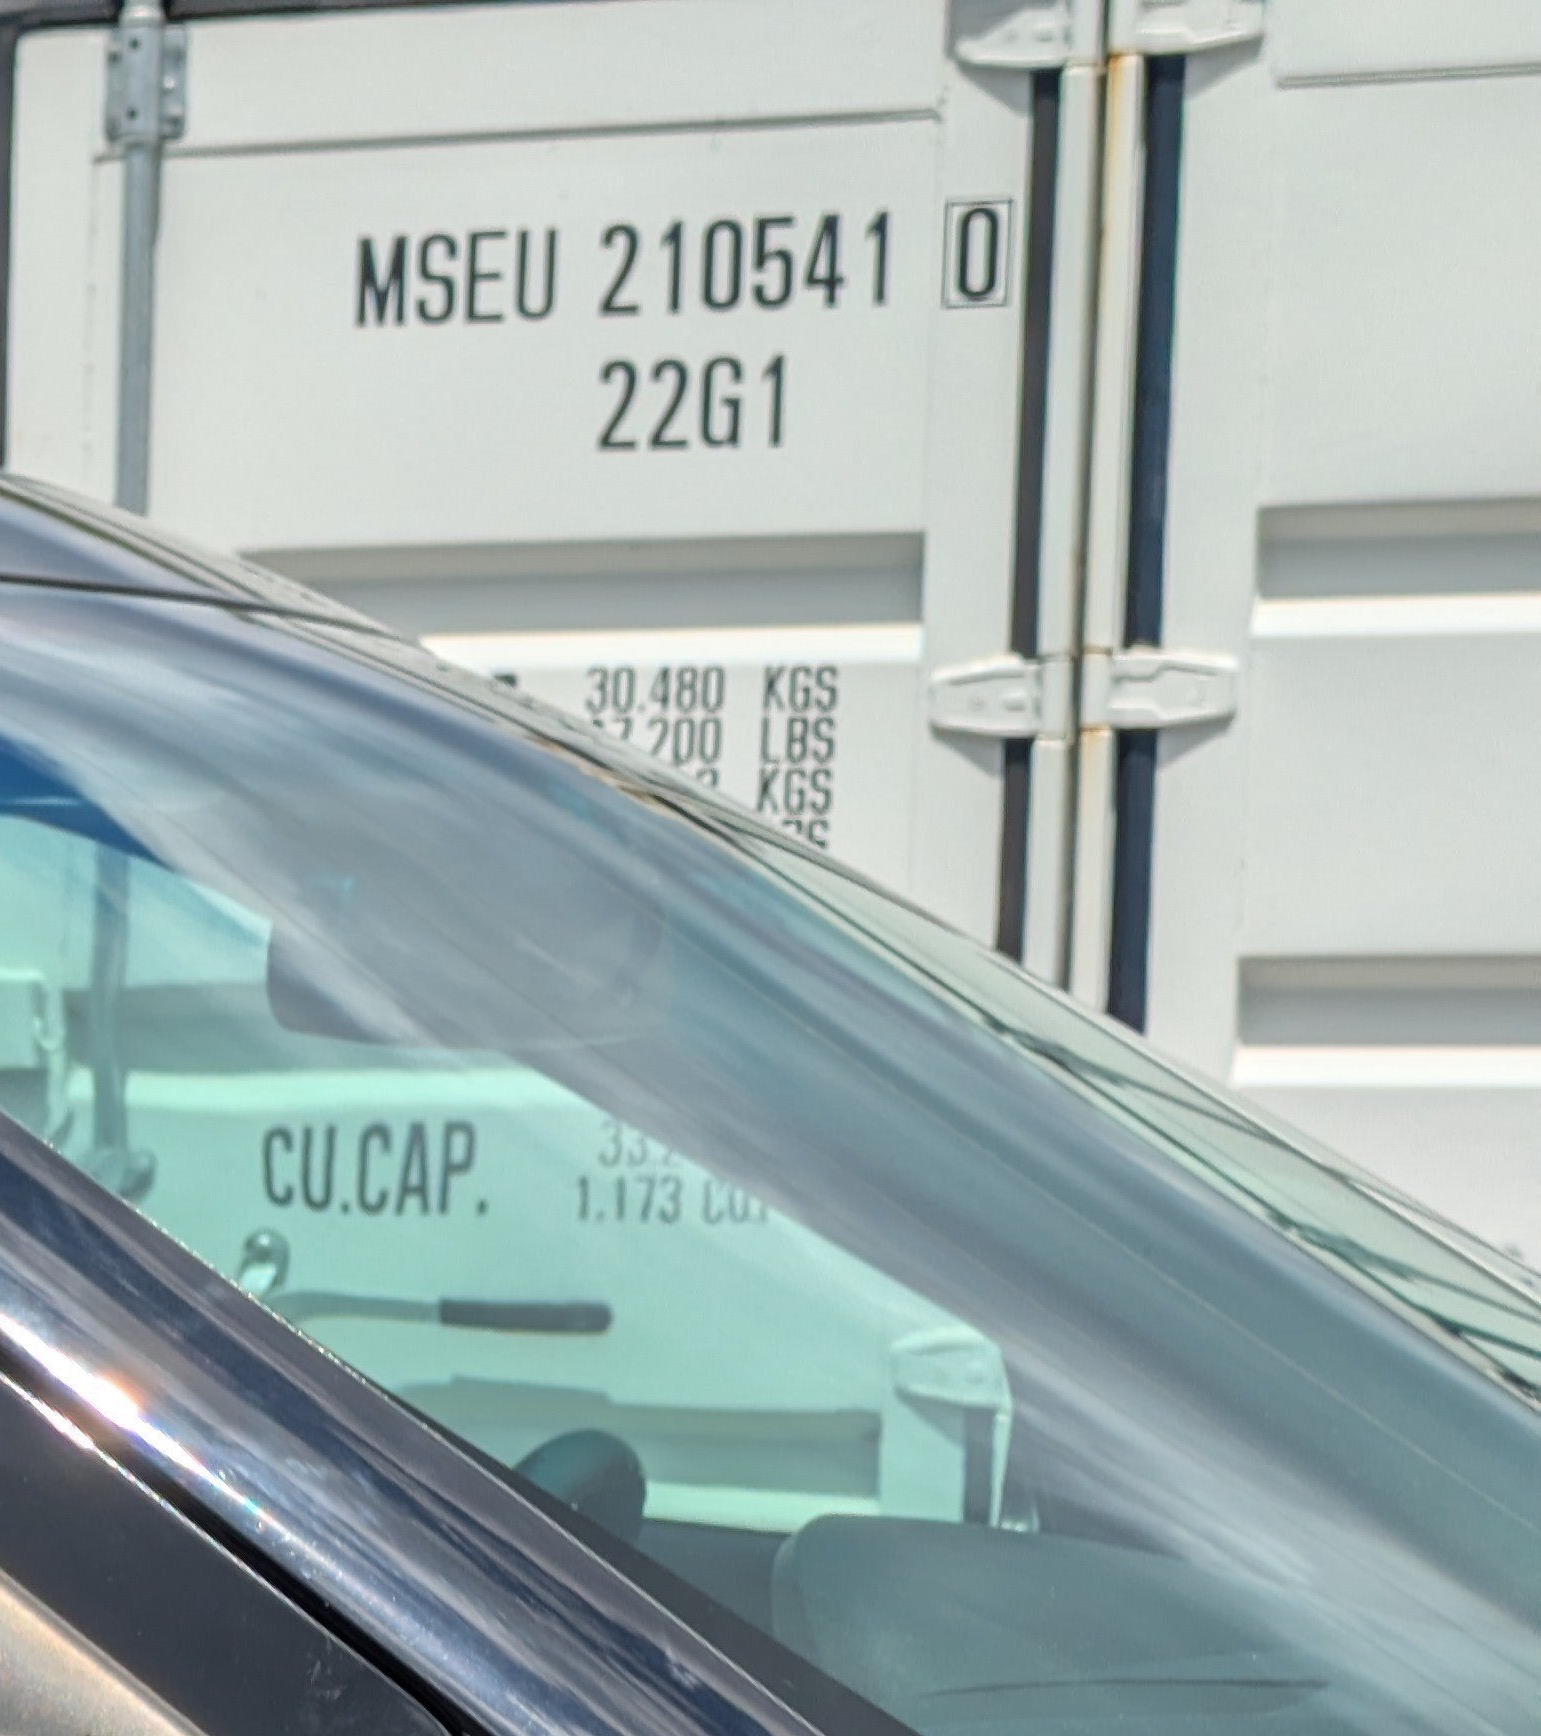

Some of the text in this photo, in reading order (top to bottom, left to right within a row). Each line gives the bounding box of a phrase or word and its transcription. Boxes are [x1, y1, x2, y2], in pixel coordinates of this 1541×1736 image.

[356, 205, 1000, 327] MSEU 210541 0
[597, 354, 787, 450] 22G1
[586, 666, 838, 713] 30.480 KGS
[760, 717, 835, 764] LBS
[757, 766, 832, 814] KGS
[262, 1120, 489, 1217] CU.CAP.
[577, 1174, 683, 1224] 1.173
